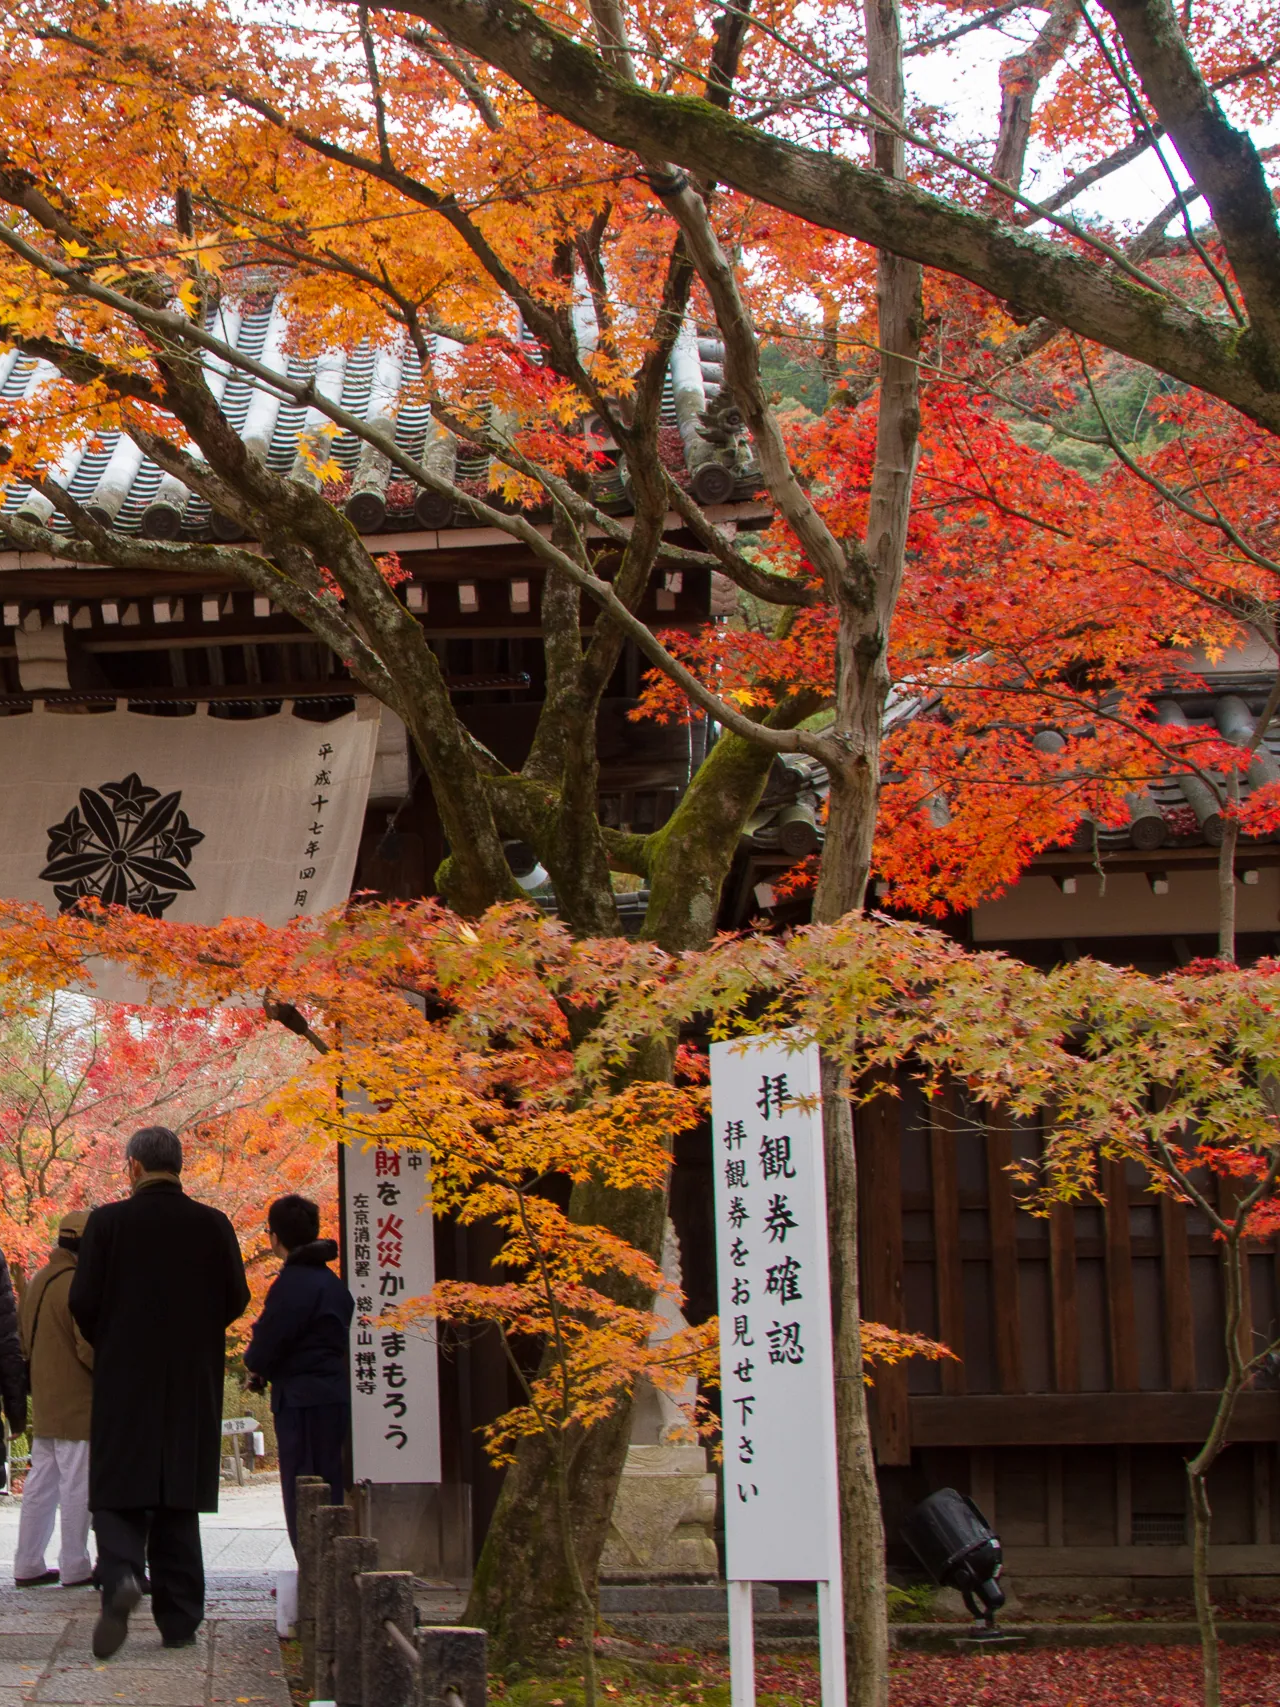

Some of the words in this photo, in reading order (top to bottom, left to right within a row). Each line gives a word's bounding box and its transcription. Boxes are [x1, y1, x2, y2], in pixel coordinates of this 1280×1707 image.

[289, 742, 335, 920] 平成十七年四月
[373, 1097, 409, 1451] 財を火災かまもろう
[722, 1119, 760, 1504] 拝観券をお見せ下さい
[755, 1072, 807, 1367] 拝観券確認
